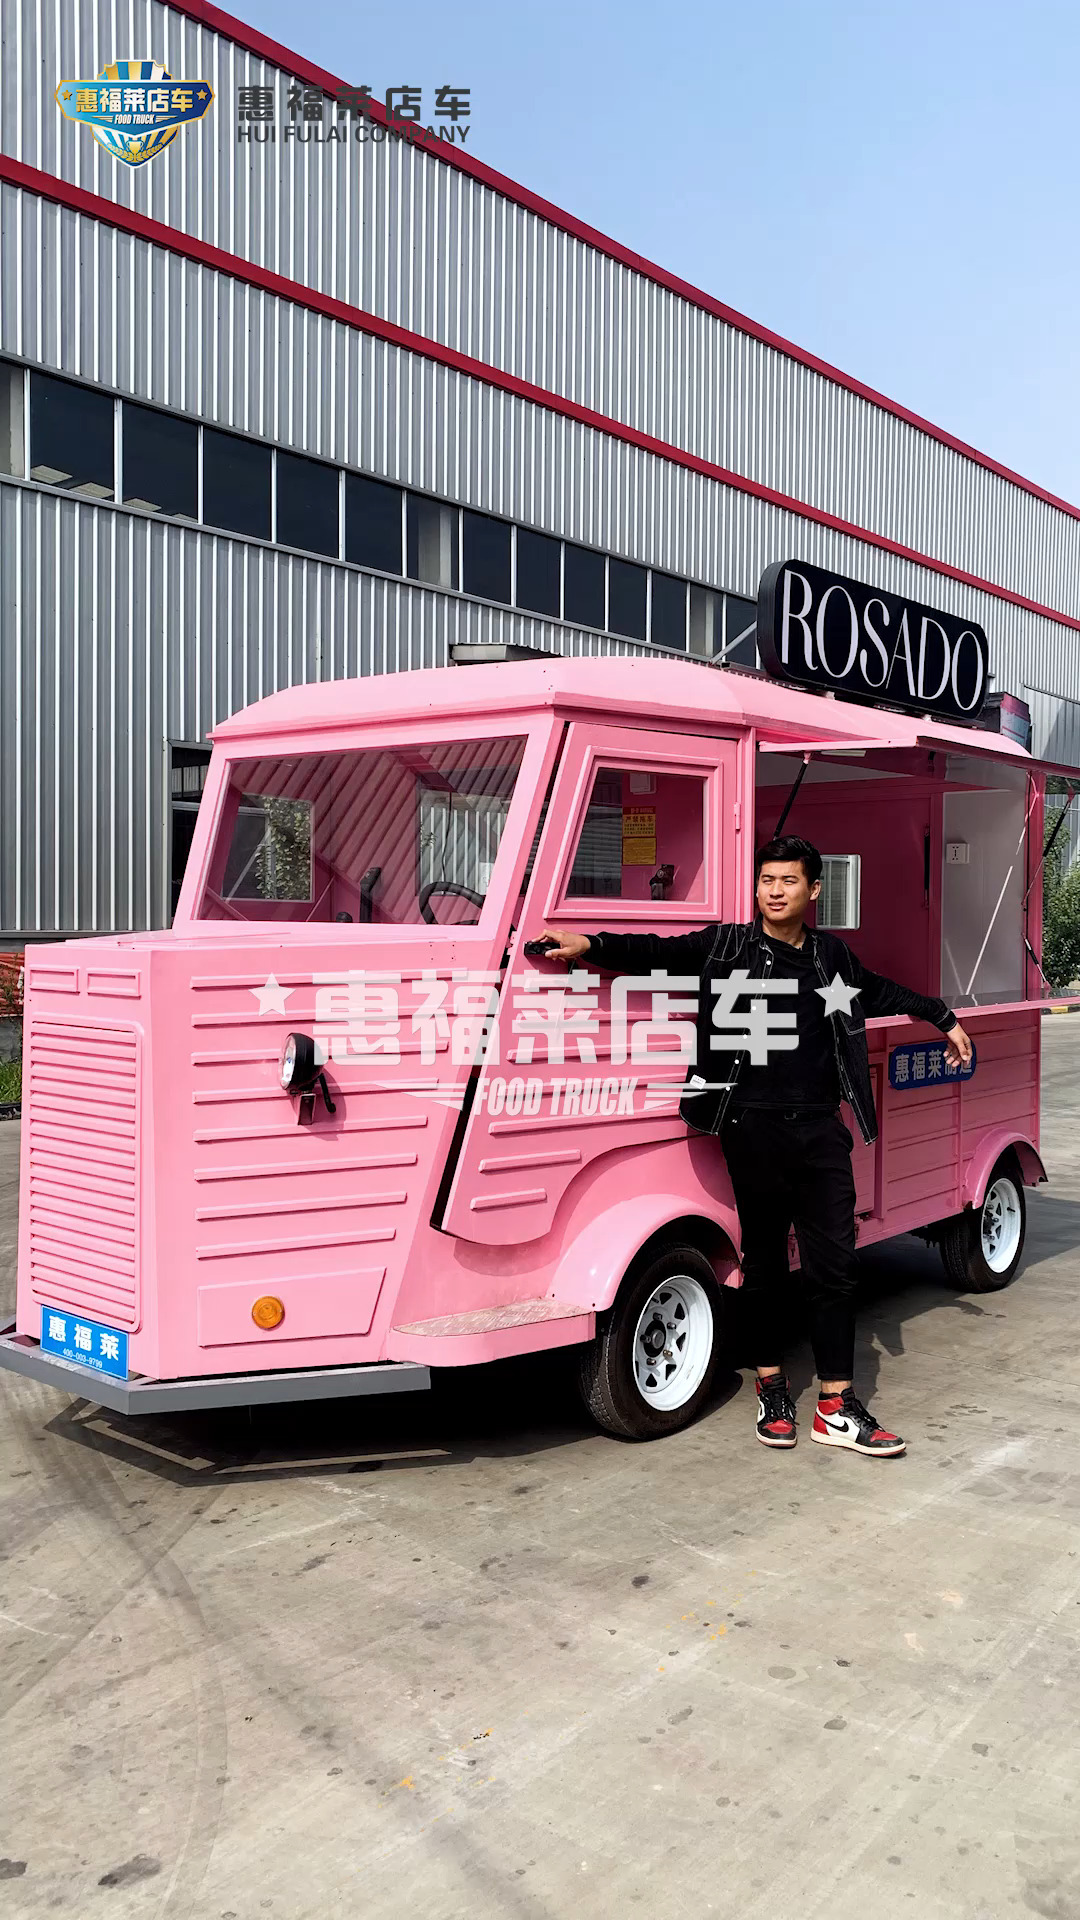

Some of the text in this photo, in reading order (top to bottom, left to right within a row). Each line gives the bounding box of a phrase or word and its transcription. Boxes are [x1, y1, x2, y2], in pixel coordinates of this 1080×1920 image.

[781, 569, 983, 710] ROSADO
[48, 1315, 120, 1361] 惠福莱
